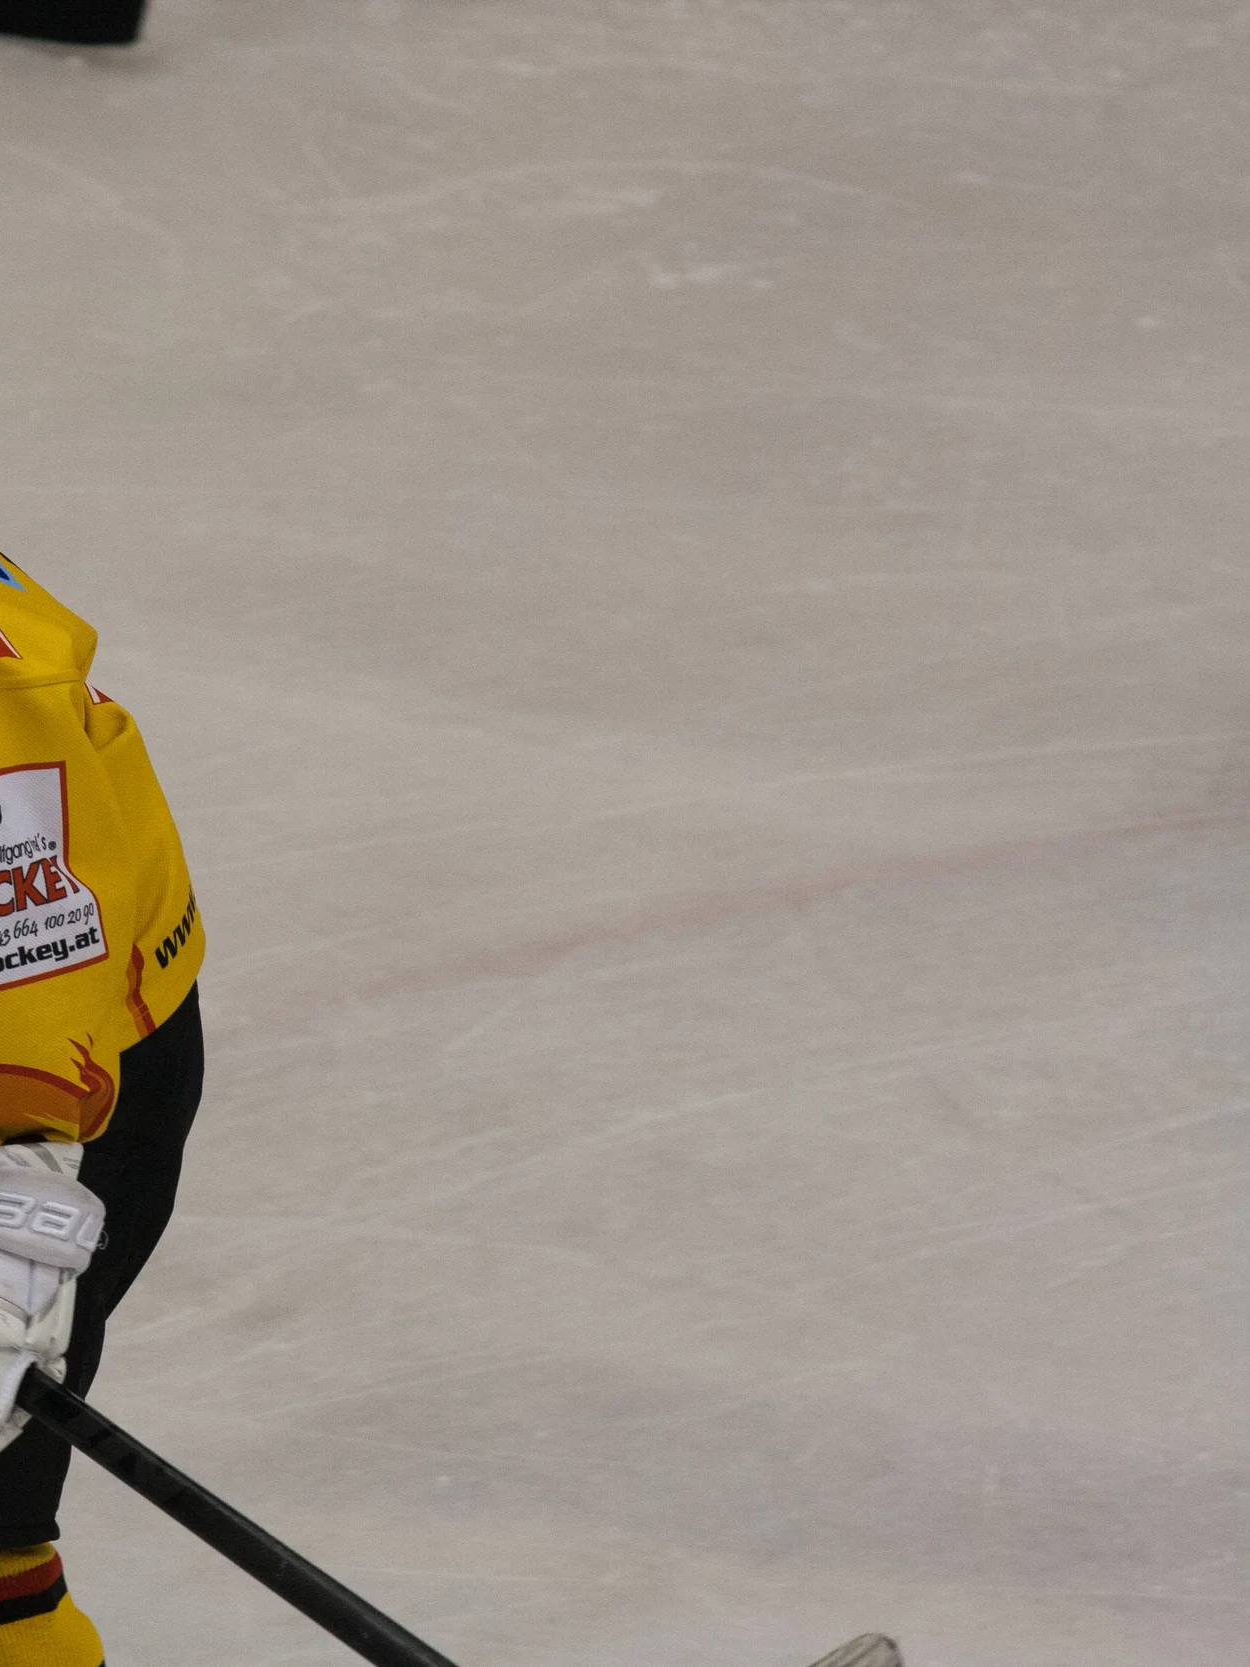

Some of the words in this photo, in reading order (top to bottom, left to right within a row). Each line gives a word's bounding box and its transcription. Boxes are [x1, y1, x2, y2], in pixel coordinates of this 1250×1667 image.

[13, 918, 39, 939] 664
[44, 913, 65, 930] 100
[67, 908, 82, 925] 20
